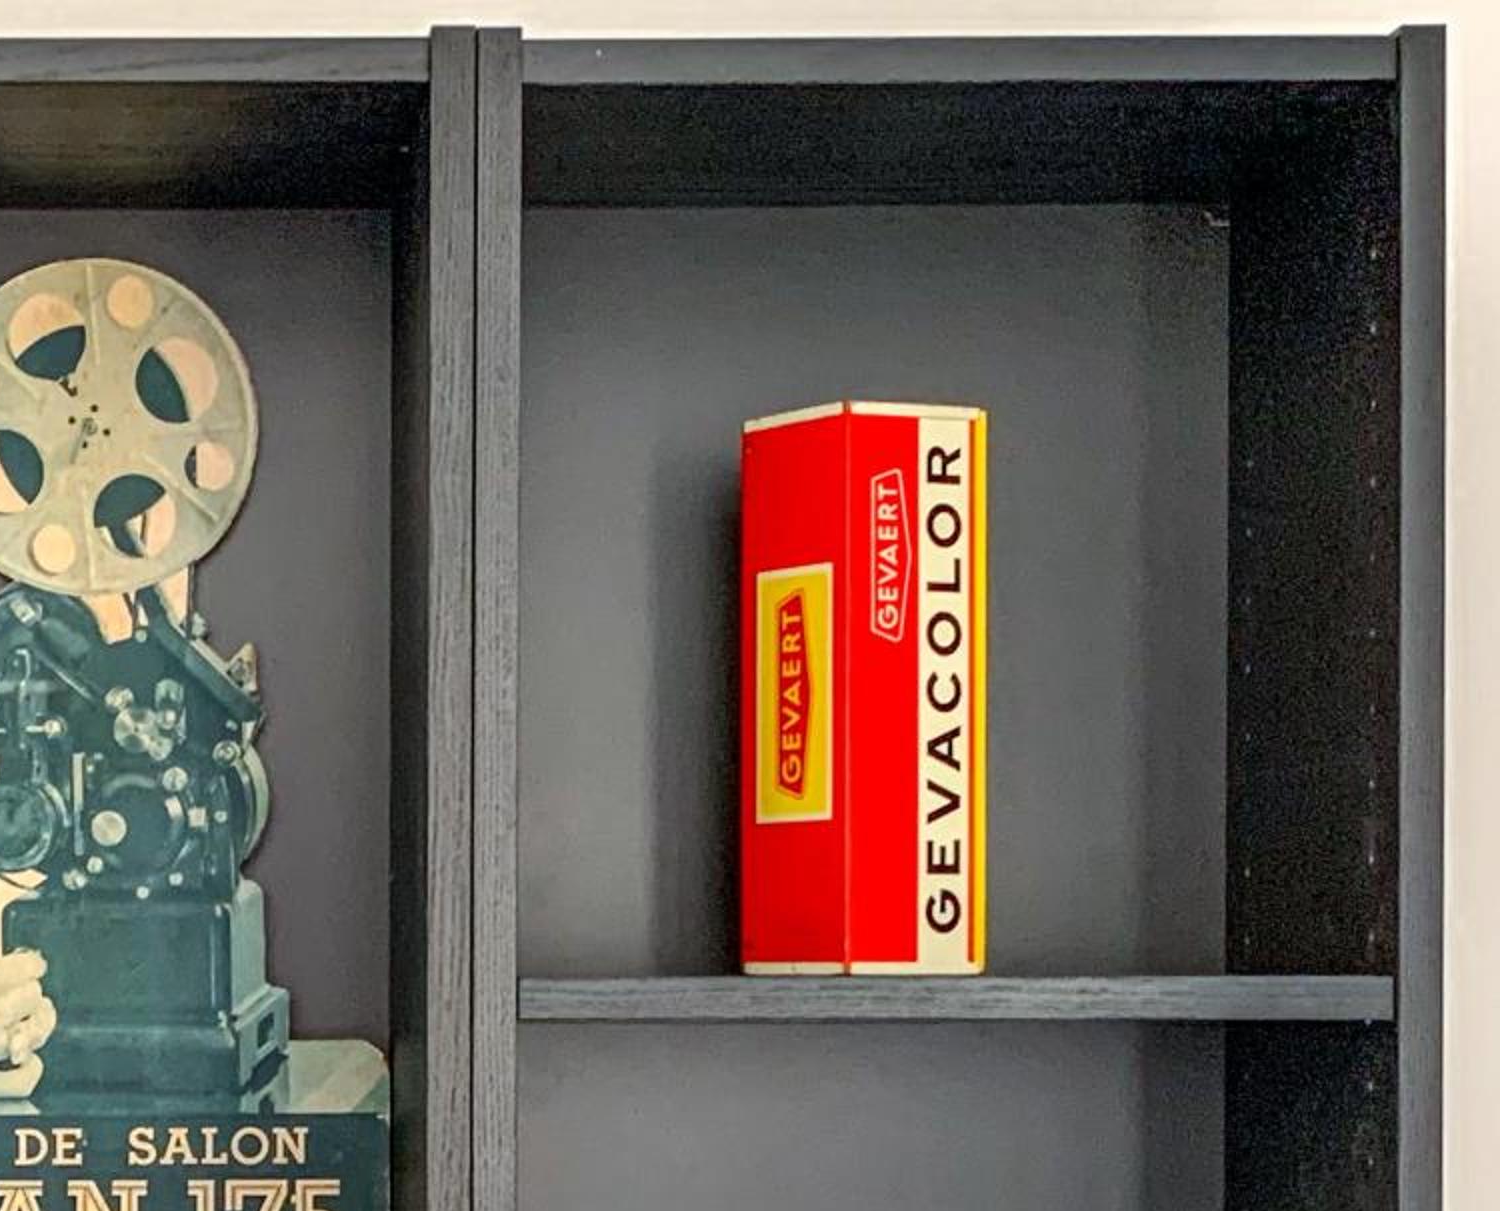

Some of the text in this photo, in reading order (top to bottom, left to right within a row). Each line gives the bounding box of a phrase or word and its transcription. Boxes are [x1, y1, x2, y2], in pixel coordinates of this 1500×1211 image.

[877, 483, 900, 630] GEVAERT
[780, 608, 803, 784] GEVAERT
[927, 445, 962, 933] GEVACOLOR
[14, 1127, 83, 1166] DE
[128, 1126, 309, 1166] SALON
